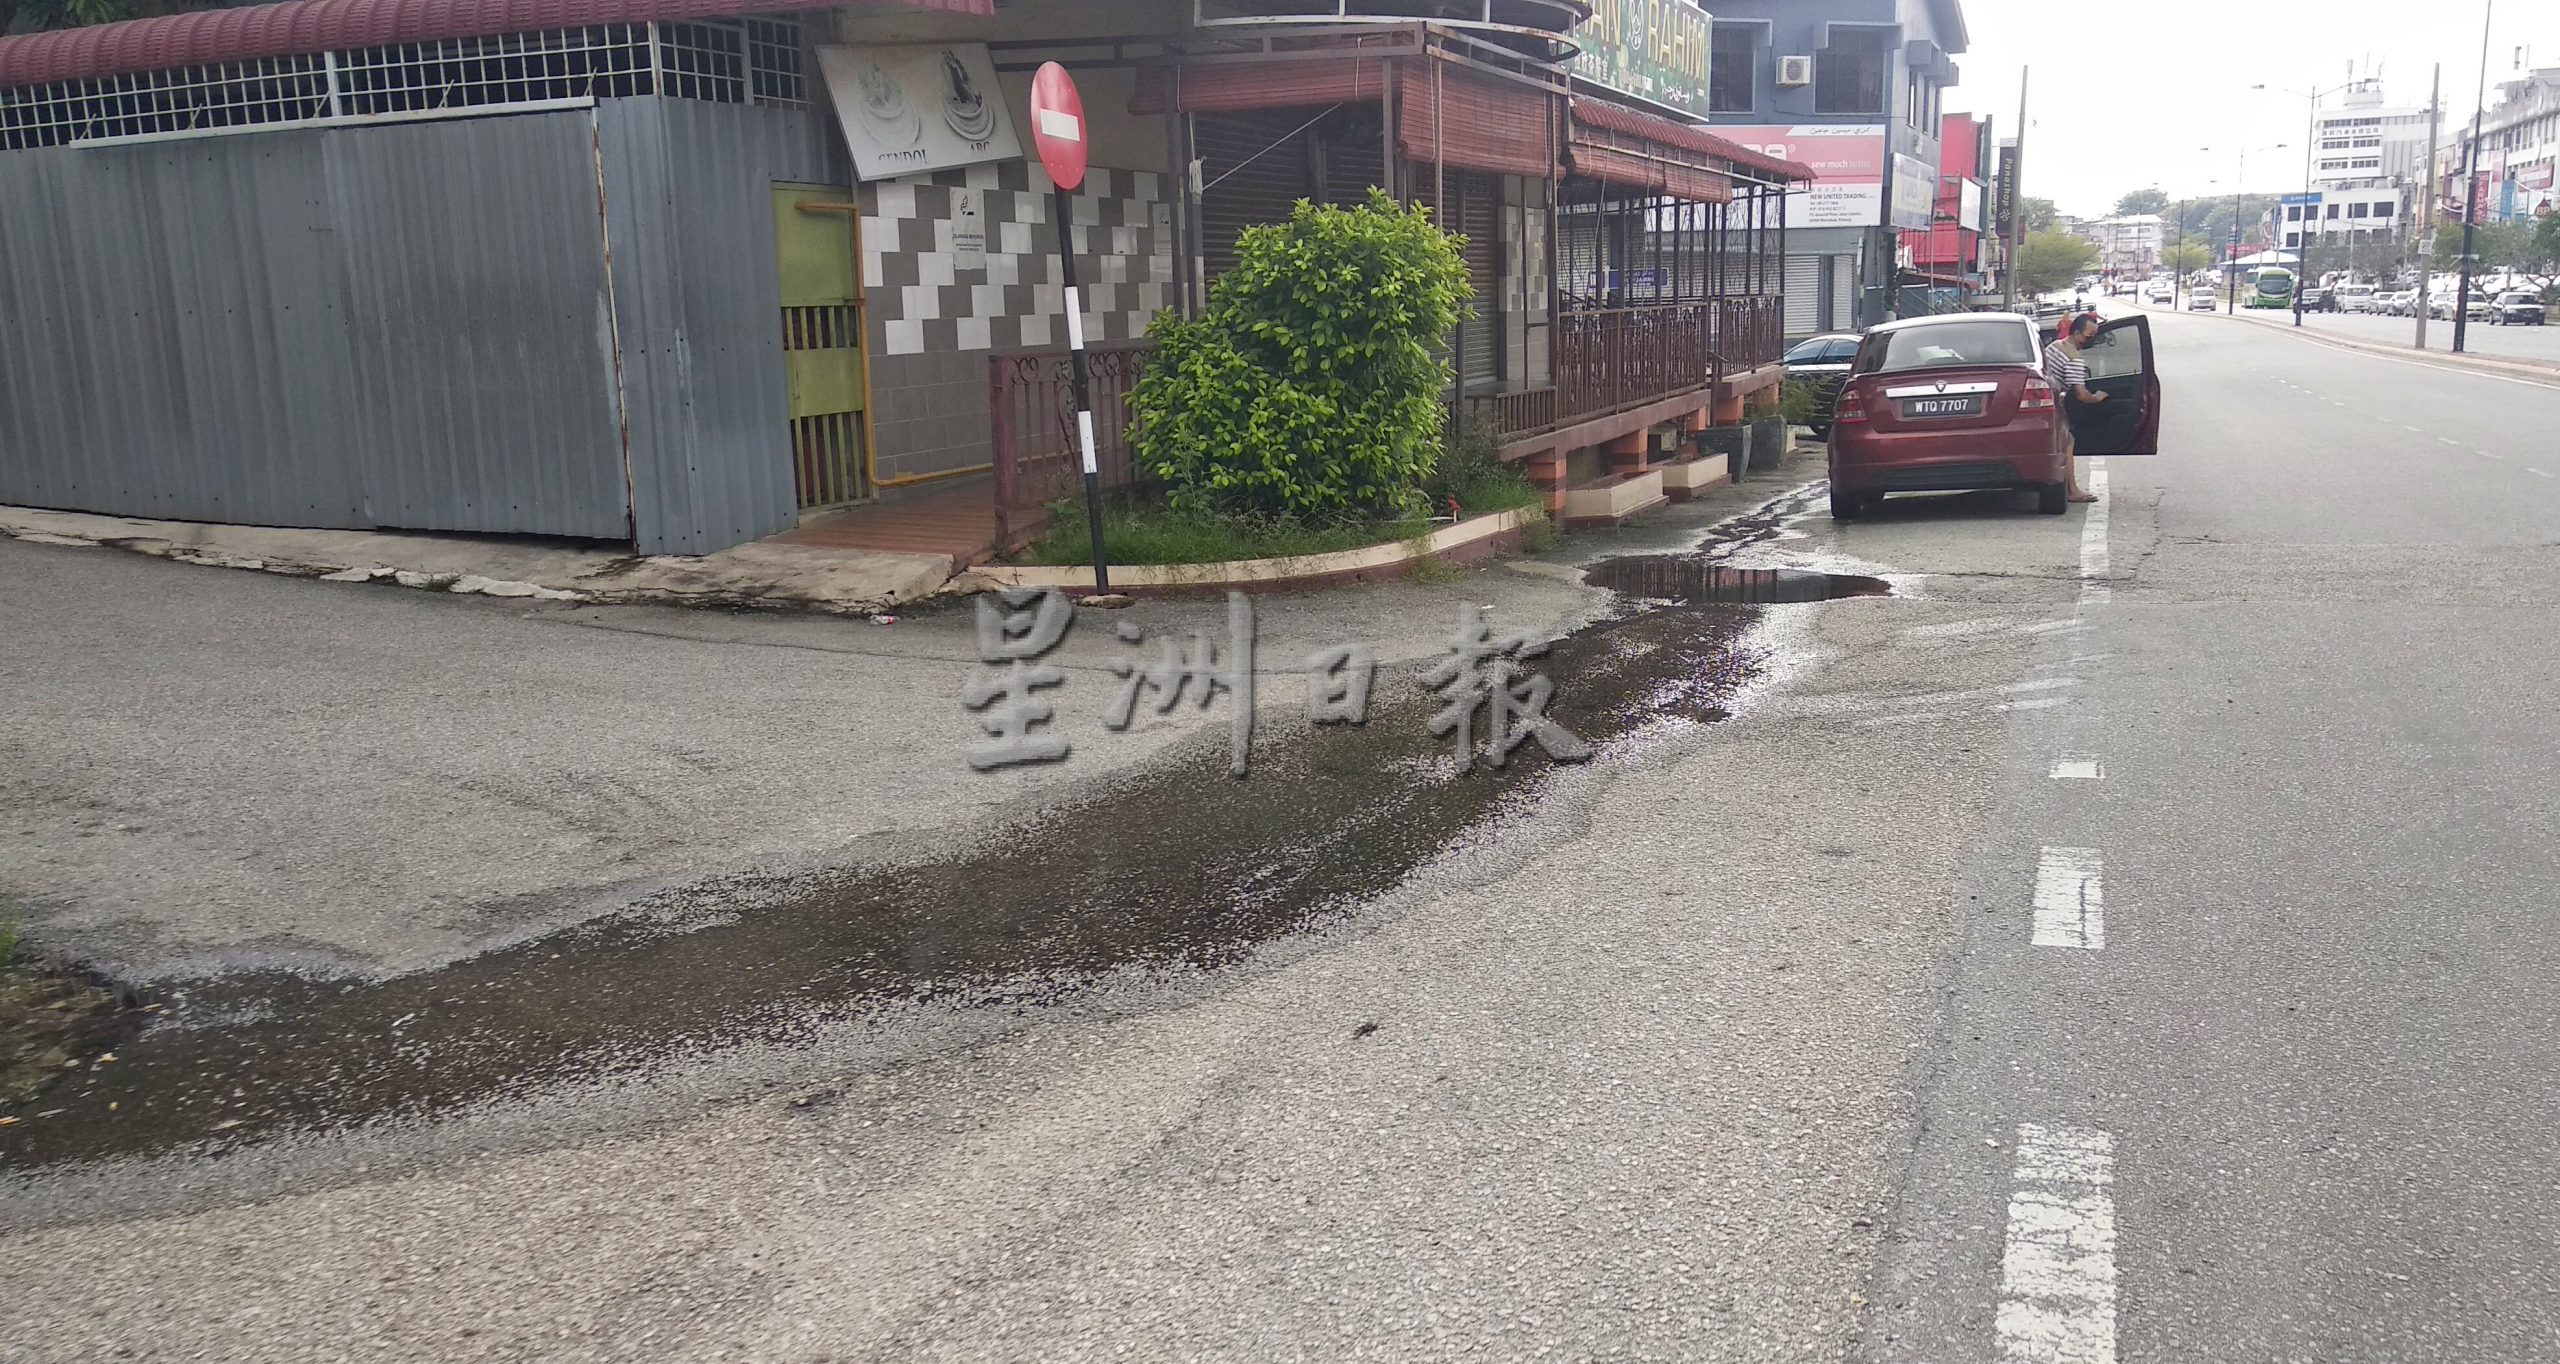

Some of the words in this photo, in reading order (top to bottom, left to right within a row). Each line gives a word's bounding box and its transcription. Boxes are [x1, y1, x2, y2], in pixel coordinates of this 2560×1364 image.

[1647, 0, 1706, 81] RAHIM
[1811, 161, 1826, 169] sew
[1827, 160, 1848, 168] much
[2001, 157, 2013, 207] Panashop
[1915, 401, 1937, 412] WTQ
[1940, 399, 1968, 411] 7707
